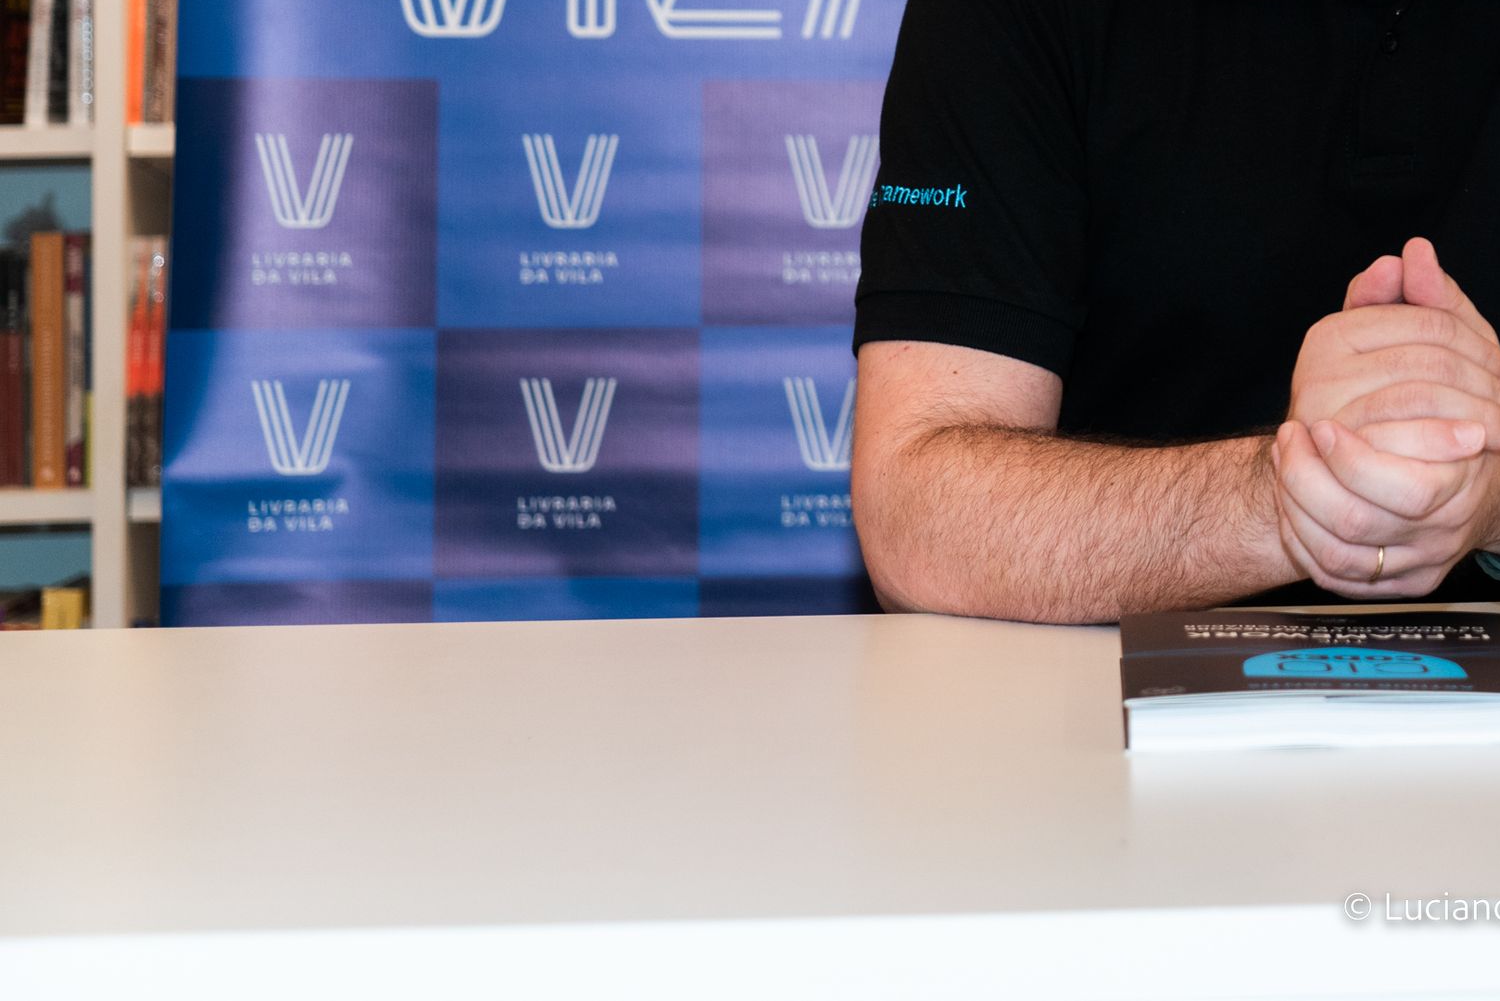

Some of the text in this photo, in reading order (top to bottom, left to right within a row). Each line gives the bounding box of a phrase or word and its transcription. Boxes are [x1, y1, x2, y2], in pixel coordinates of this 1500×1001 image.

[252, 251, 353, 269] LIVRARIA
[519, 251, 618, 268] LIVRARIA
[252, 268, 338, 286] DA VILA
[520, 267, 604, 285] DA VILA
[248, 498, 349, 516] LIVRARIA
[517, 495, 616, 513] LIVRARIA
[248, 515, 333, 533] DA VILA
[517, 512, 602, 529] DA VILA
[781, 510, 811, 528] DA
[1276, 653, 1423, 662] CODEX
